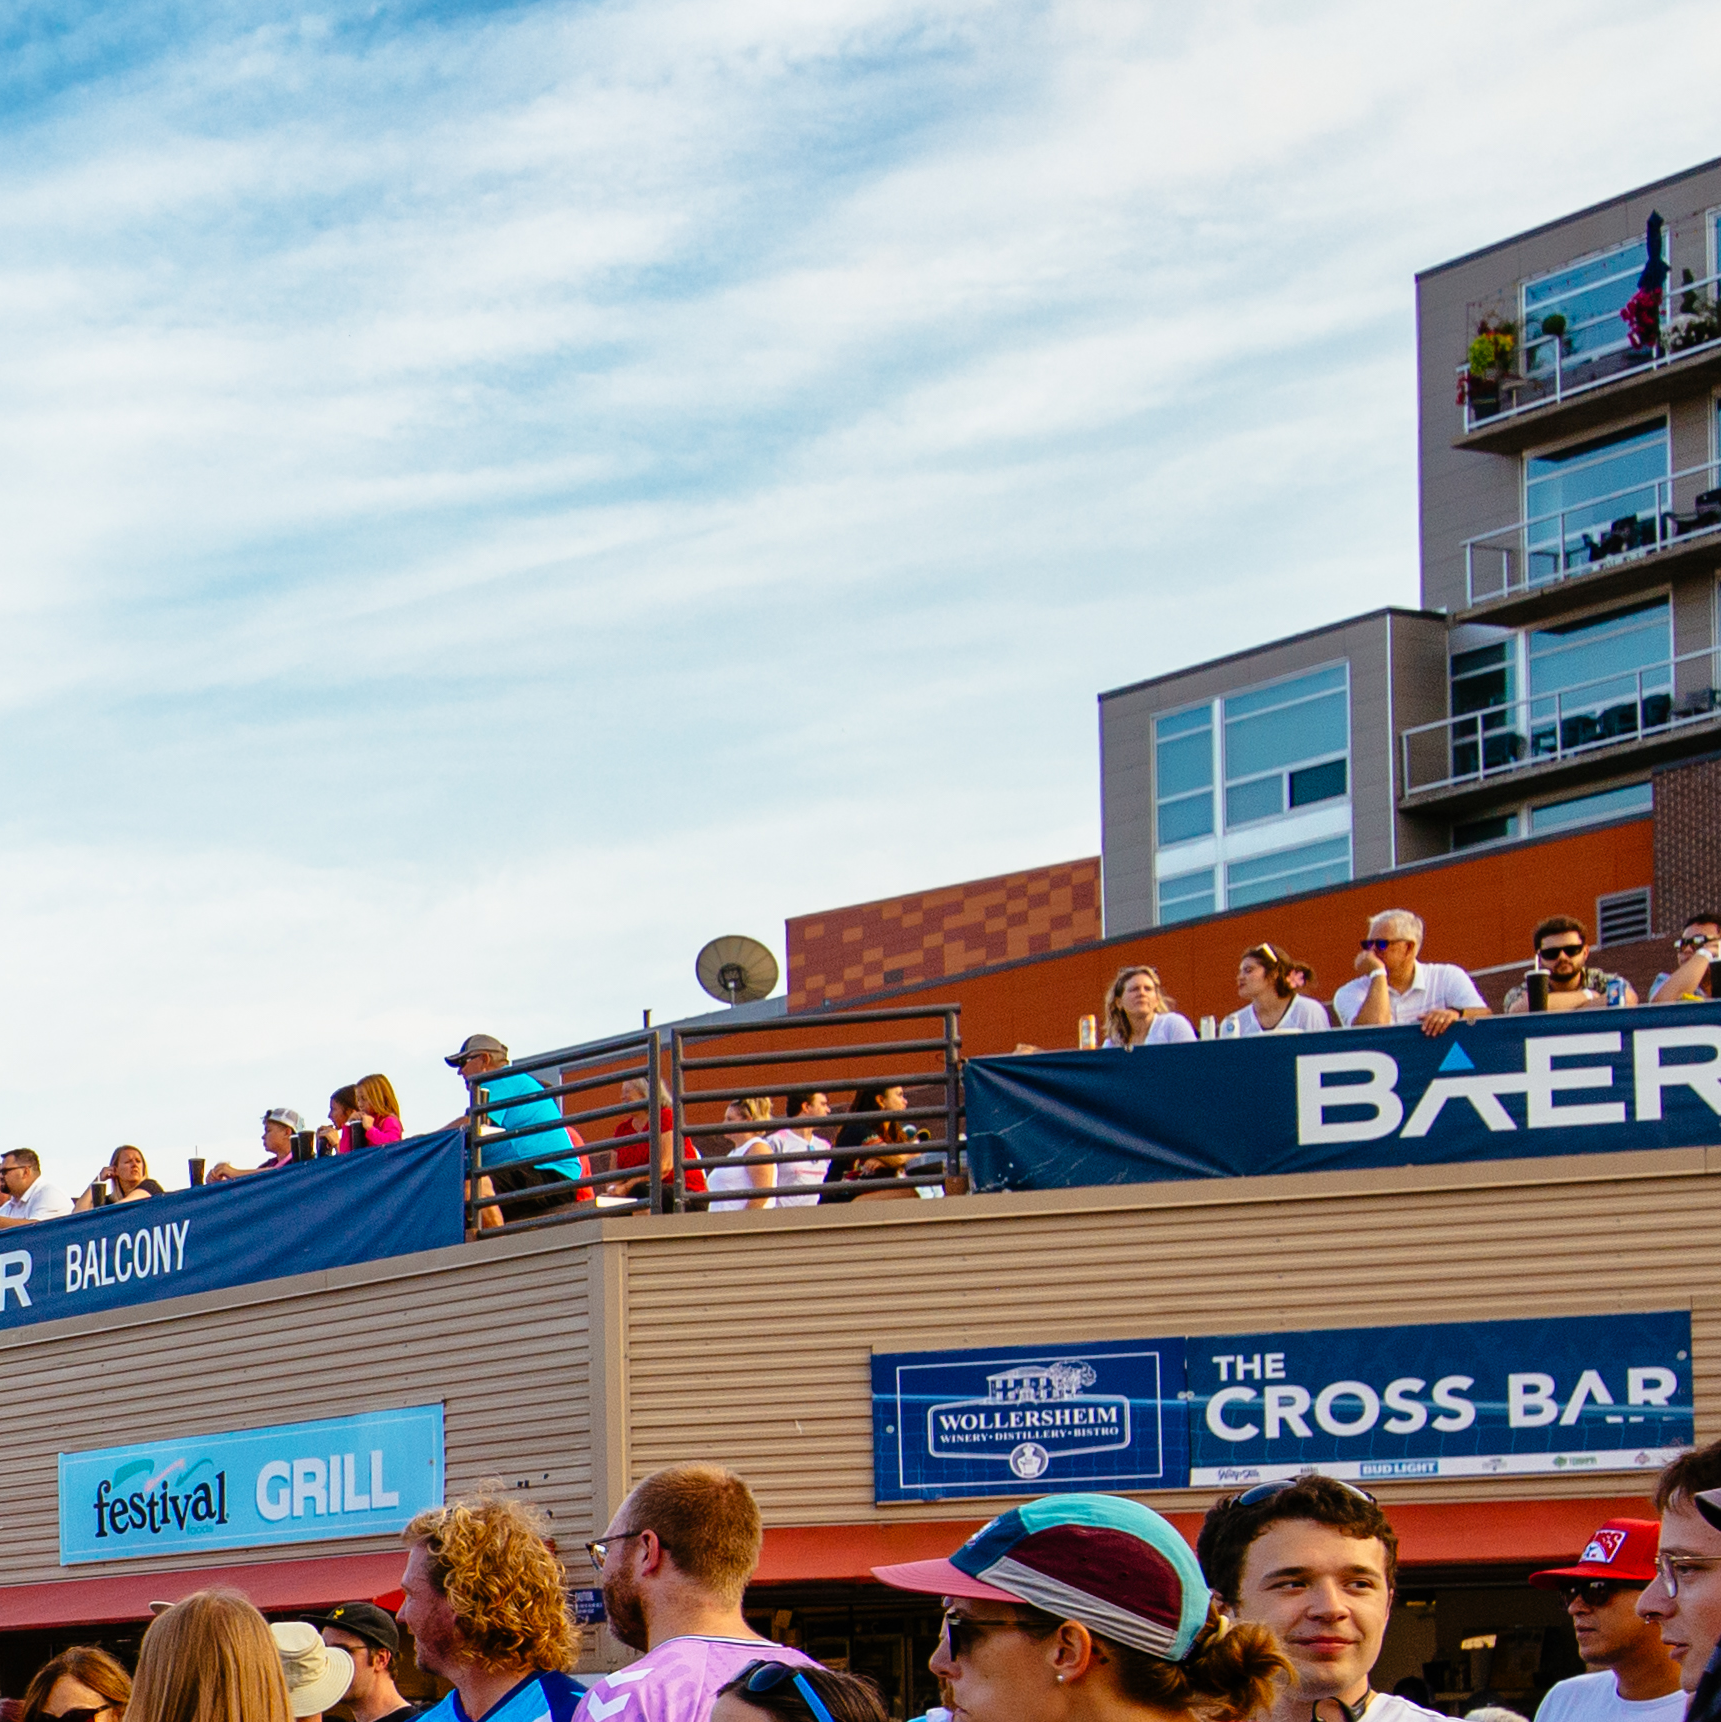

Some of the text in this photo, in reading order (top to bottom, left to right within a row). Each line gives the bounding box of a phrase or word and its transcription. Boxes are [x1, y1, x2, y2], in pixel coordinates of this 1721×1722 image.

[1296, 1024, 1721, 1145] BAER
[65, 1219, 191, 1293] BALCONY
[1205, 1366, 1678, 1441] CROSS BAR
[1212, 1352, 1286, 1381] THE
[939, 1406, 1118, 1431] WOLLERSHEIM
[93, 1450, 400, 1538] festival GRILL
[1362, 1461, 1436, 1475] BUD LIGHT
